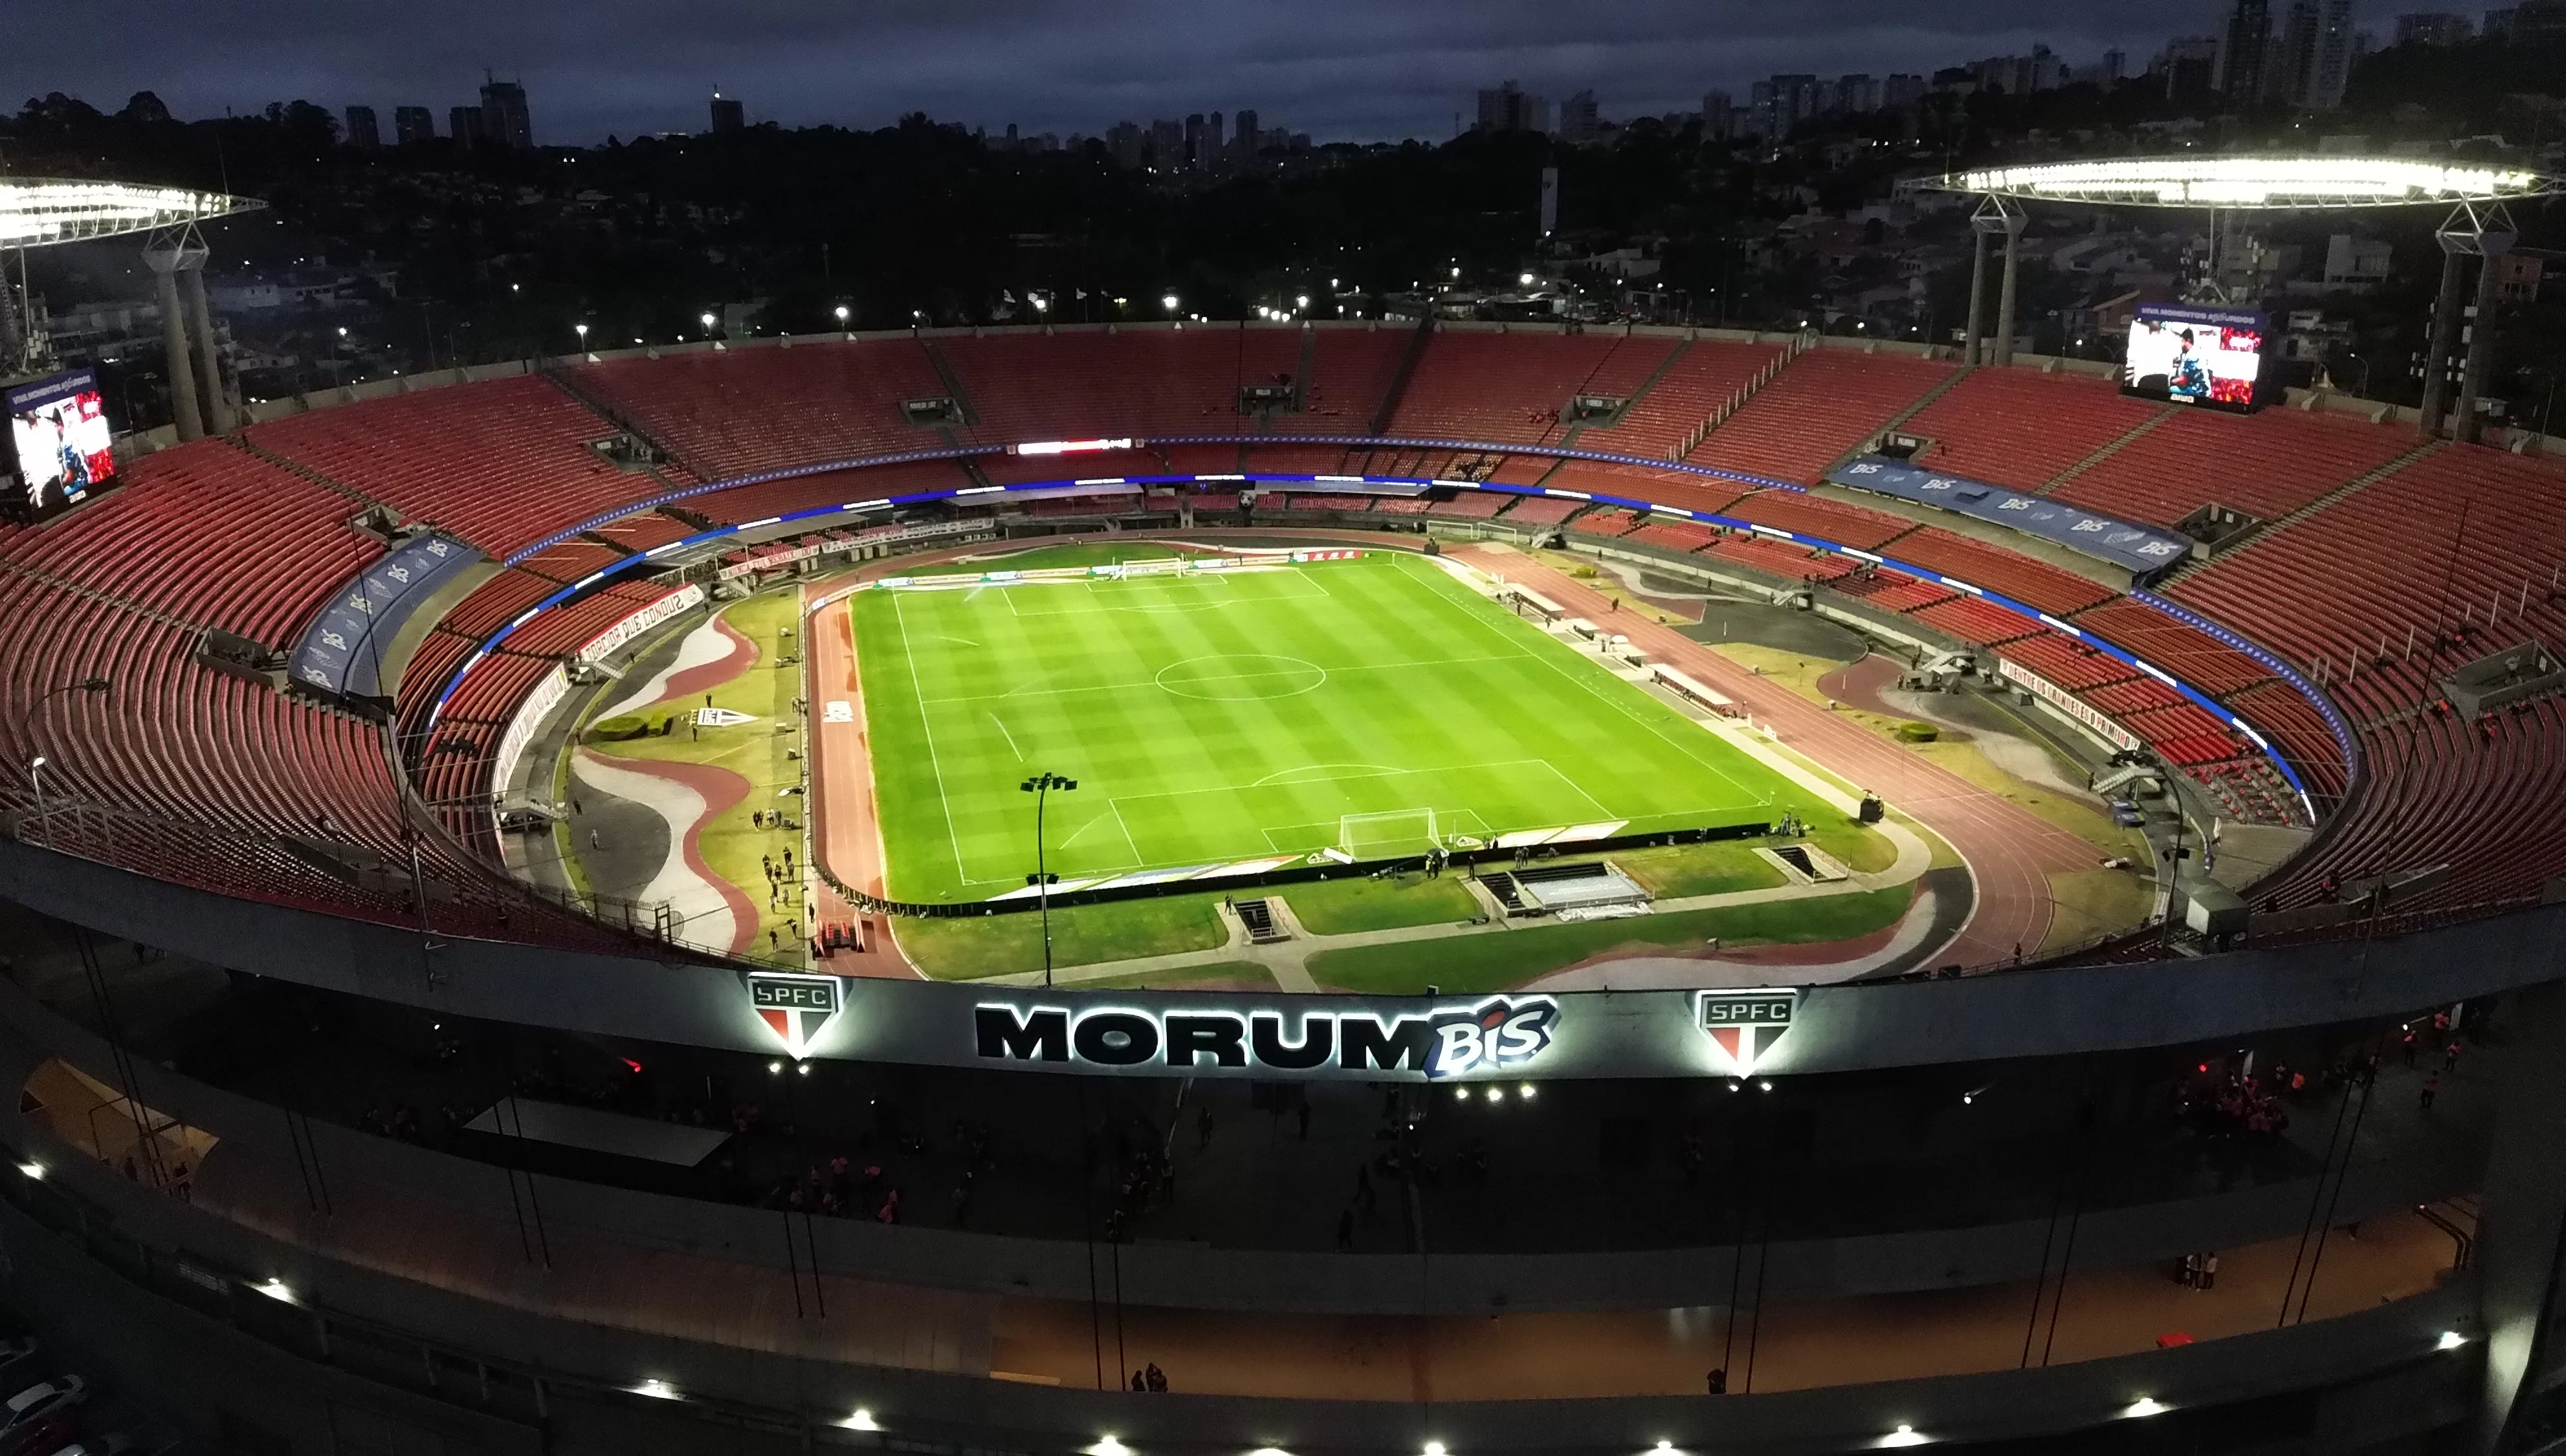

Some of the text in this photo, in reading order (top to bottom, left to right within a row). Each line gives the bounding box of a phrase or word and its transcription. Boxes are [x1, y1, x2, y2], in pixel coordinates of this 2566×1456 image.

[585, 594, 685, 661] TORCIDA QUE CONDUZ
[2009, 666, 2035, 689] DENTRE
[2037, 679, 2046, 695] OS
[2048, 686, 2079, 716] GRANDES
[2090, 712, 2096, 725] O
[2097, 718, 2130, 749] PRIMEIRO
[757, 987, 826, 1005] SPFC
[1711, 1003, 1787, 1020] SPFC
